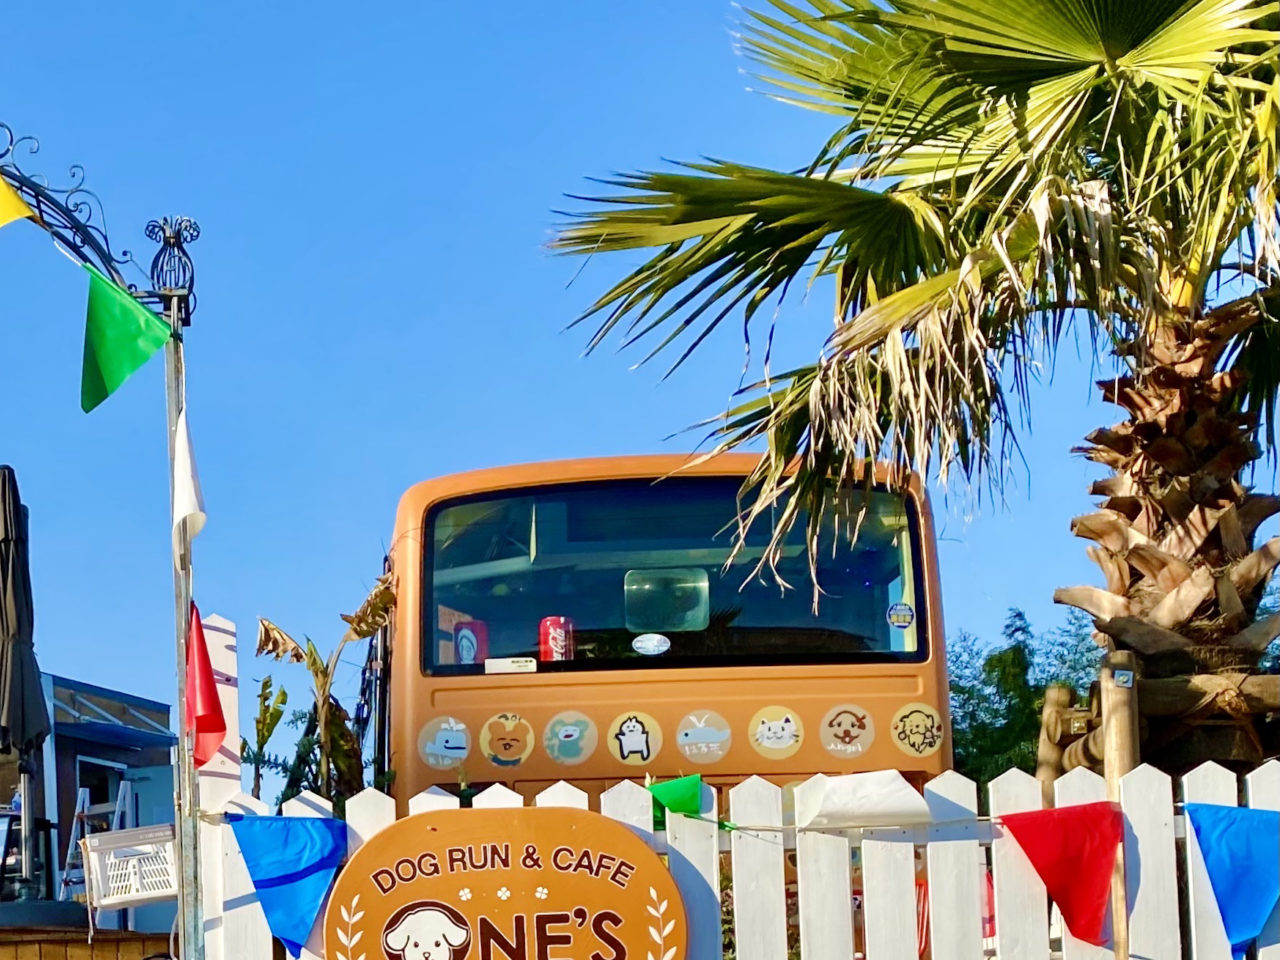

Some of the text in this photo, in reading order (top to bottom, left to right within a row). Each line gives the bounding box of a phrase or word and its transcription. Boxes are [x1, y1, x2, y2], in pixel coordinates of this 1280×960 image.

[371, 844, 636, 895] DOG RUN & CAFE
